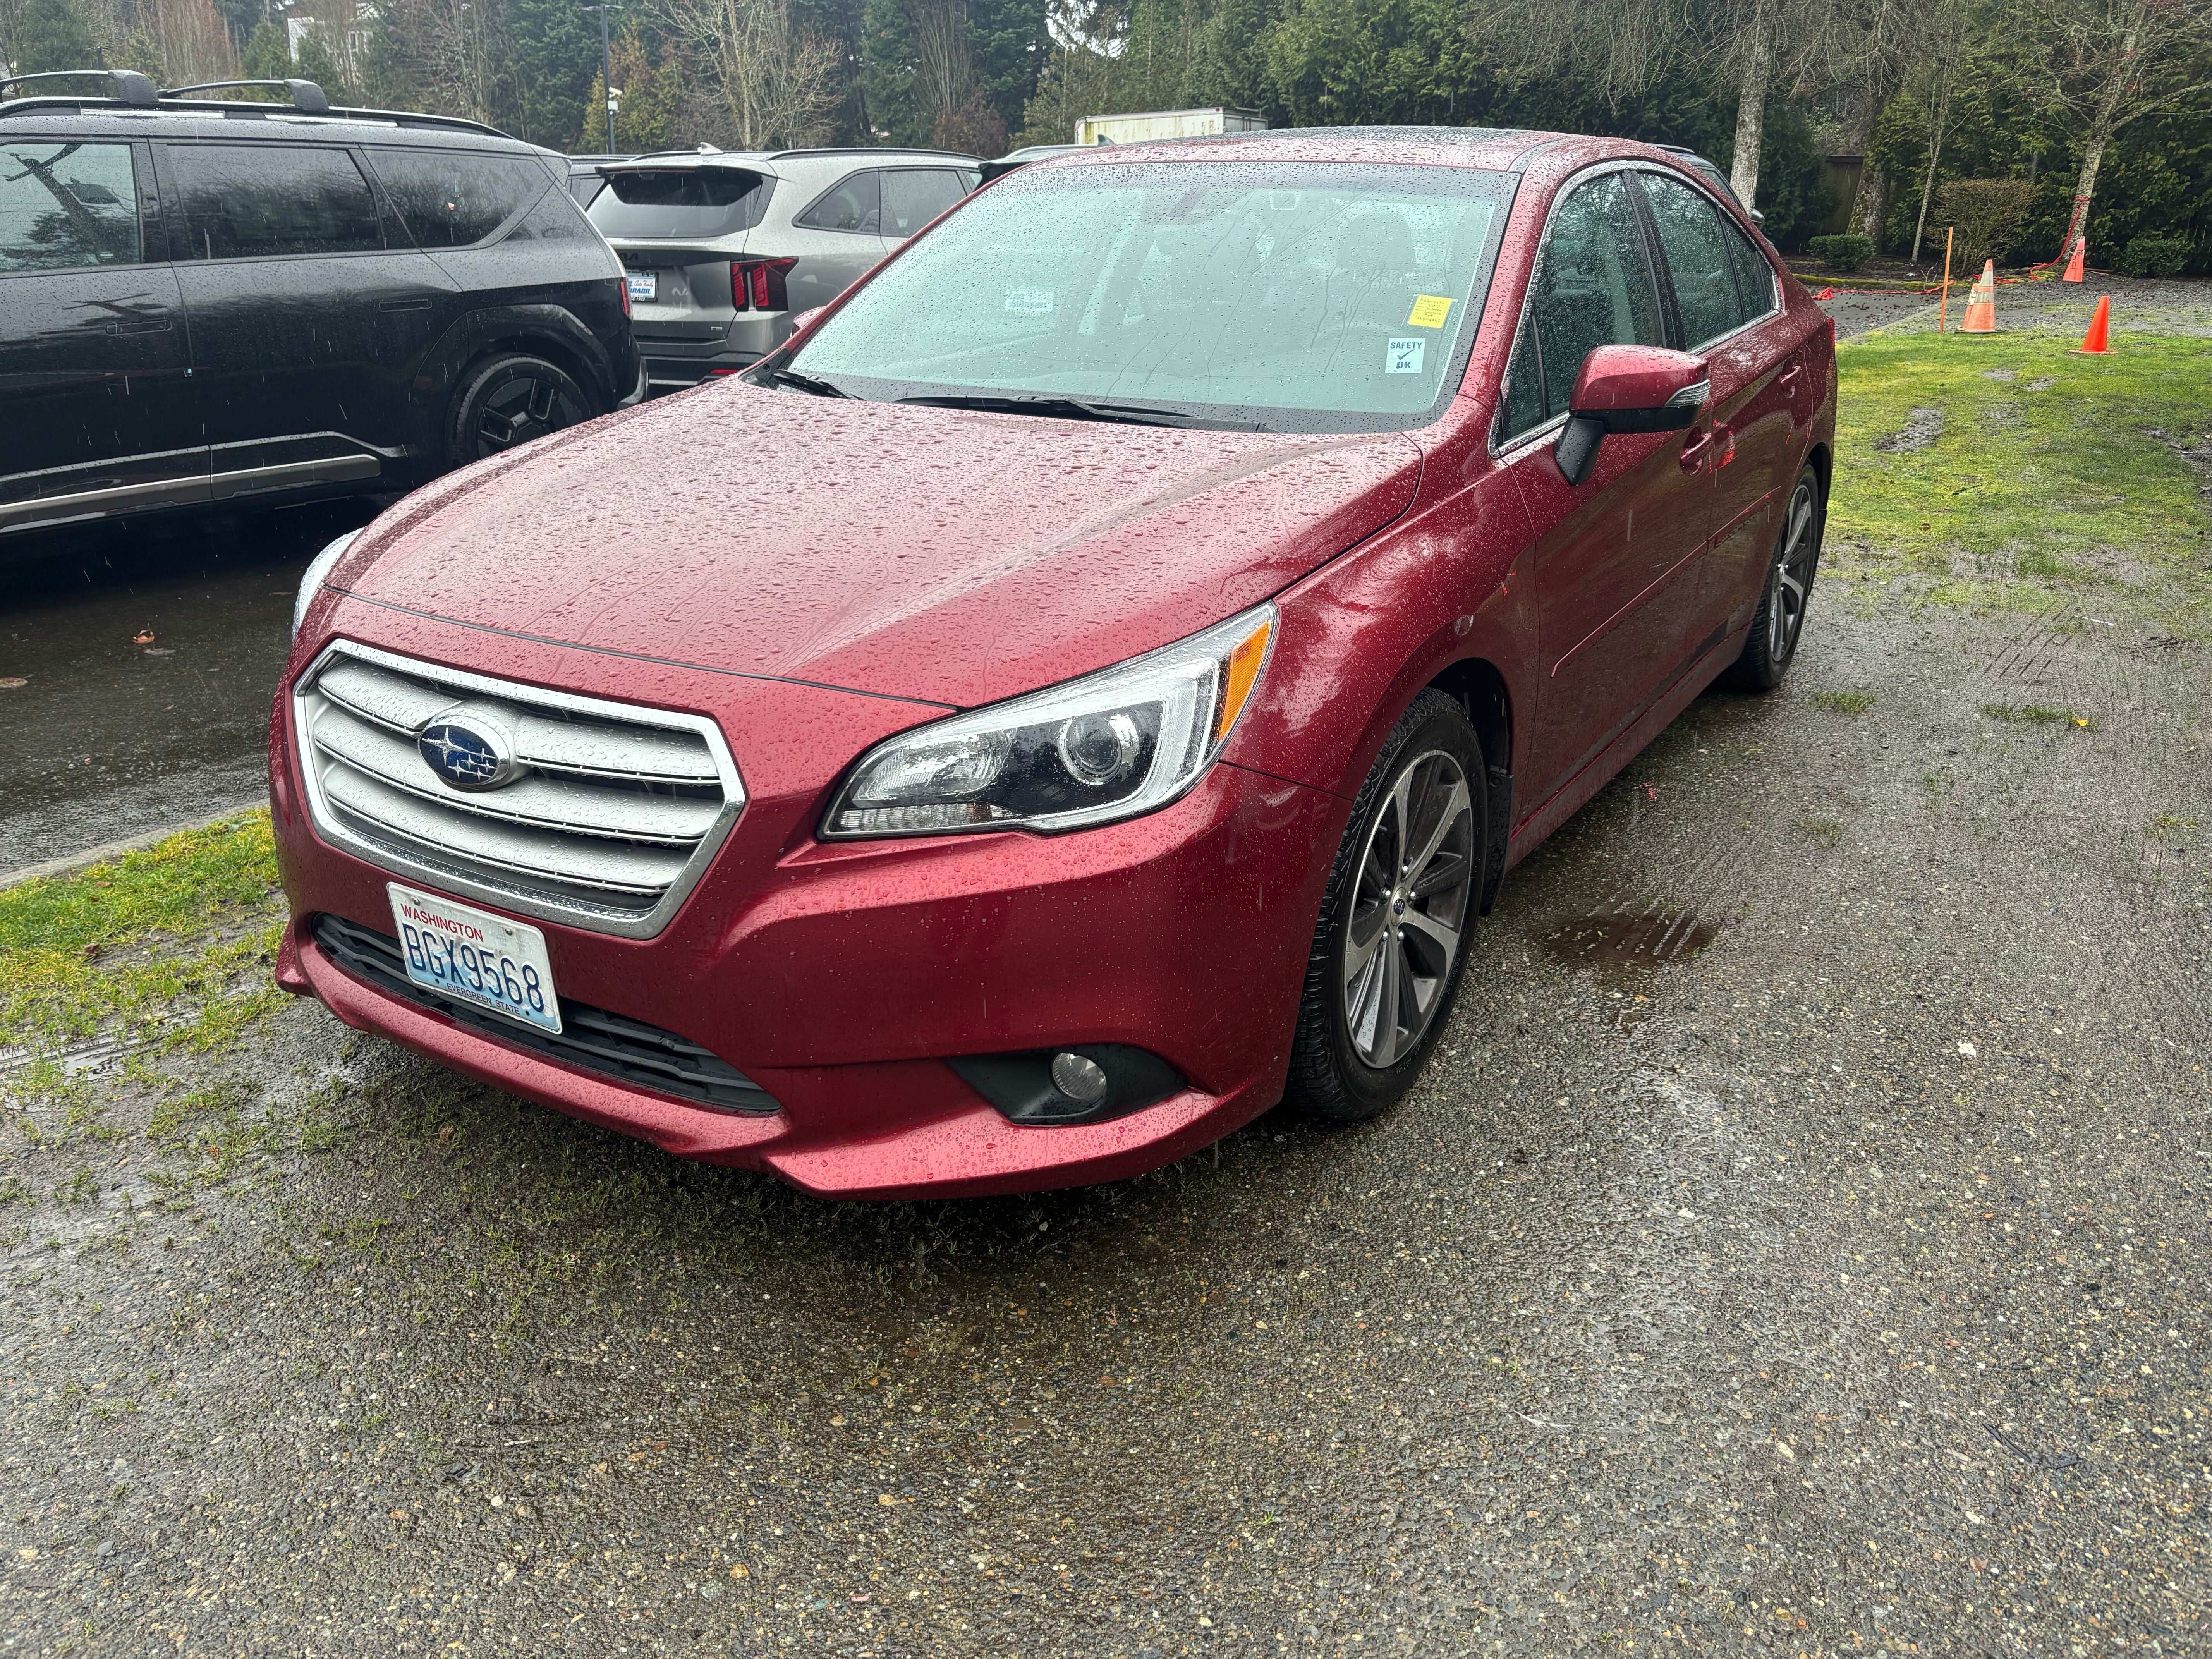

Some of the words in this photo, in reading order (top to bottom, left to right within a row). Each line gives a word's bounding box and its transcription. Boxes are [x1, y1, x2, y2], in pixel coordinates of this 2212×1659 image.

[401, 903, 484, 942] WASHINGTON
[402, 923, 544, 1013] BGX9568
[447, 983, 492, 1005] EVERGREEN
[495, 1000, 520, 1015] STATE
